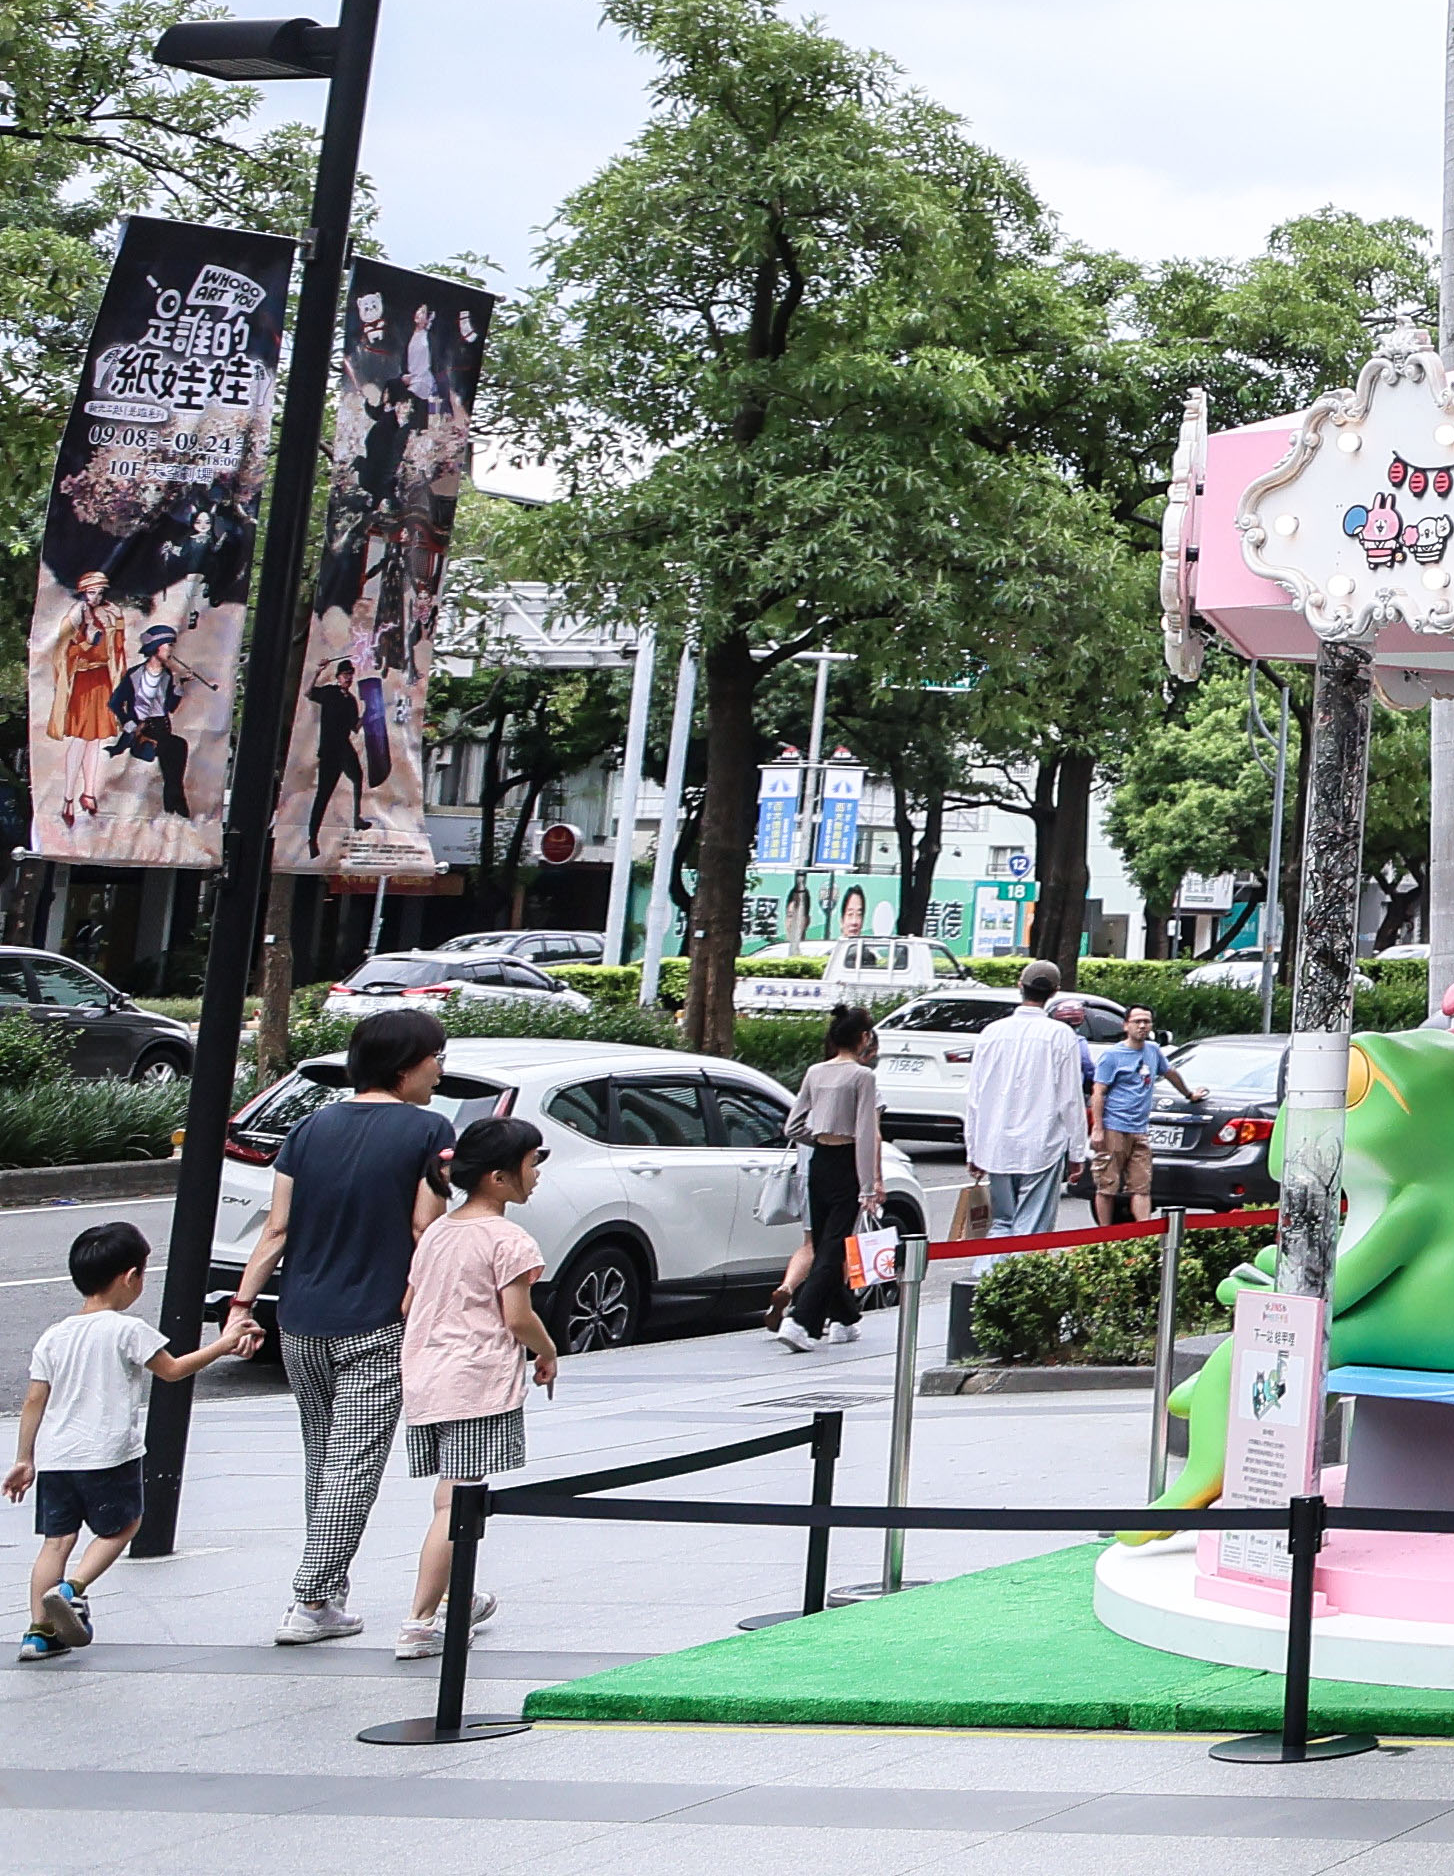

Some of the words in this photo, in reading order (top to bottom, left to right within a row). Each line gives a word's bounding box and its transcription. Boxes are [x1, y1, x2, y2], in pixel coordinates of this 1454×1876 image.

[201, 269, 260, 298] WHOOO
[195, 285, 228, 302] ART
[233, 291, 257, 308] YOU
[110, 346, 254, 411] 紙娃娃
[110, 460, 142, 477] 10F
[1012, 858, 1027, 870] 12
[1008, 884, 1026, 898] 18
